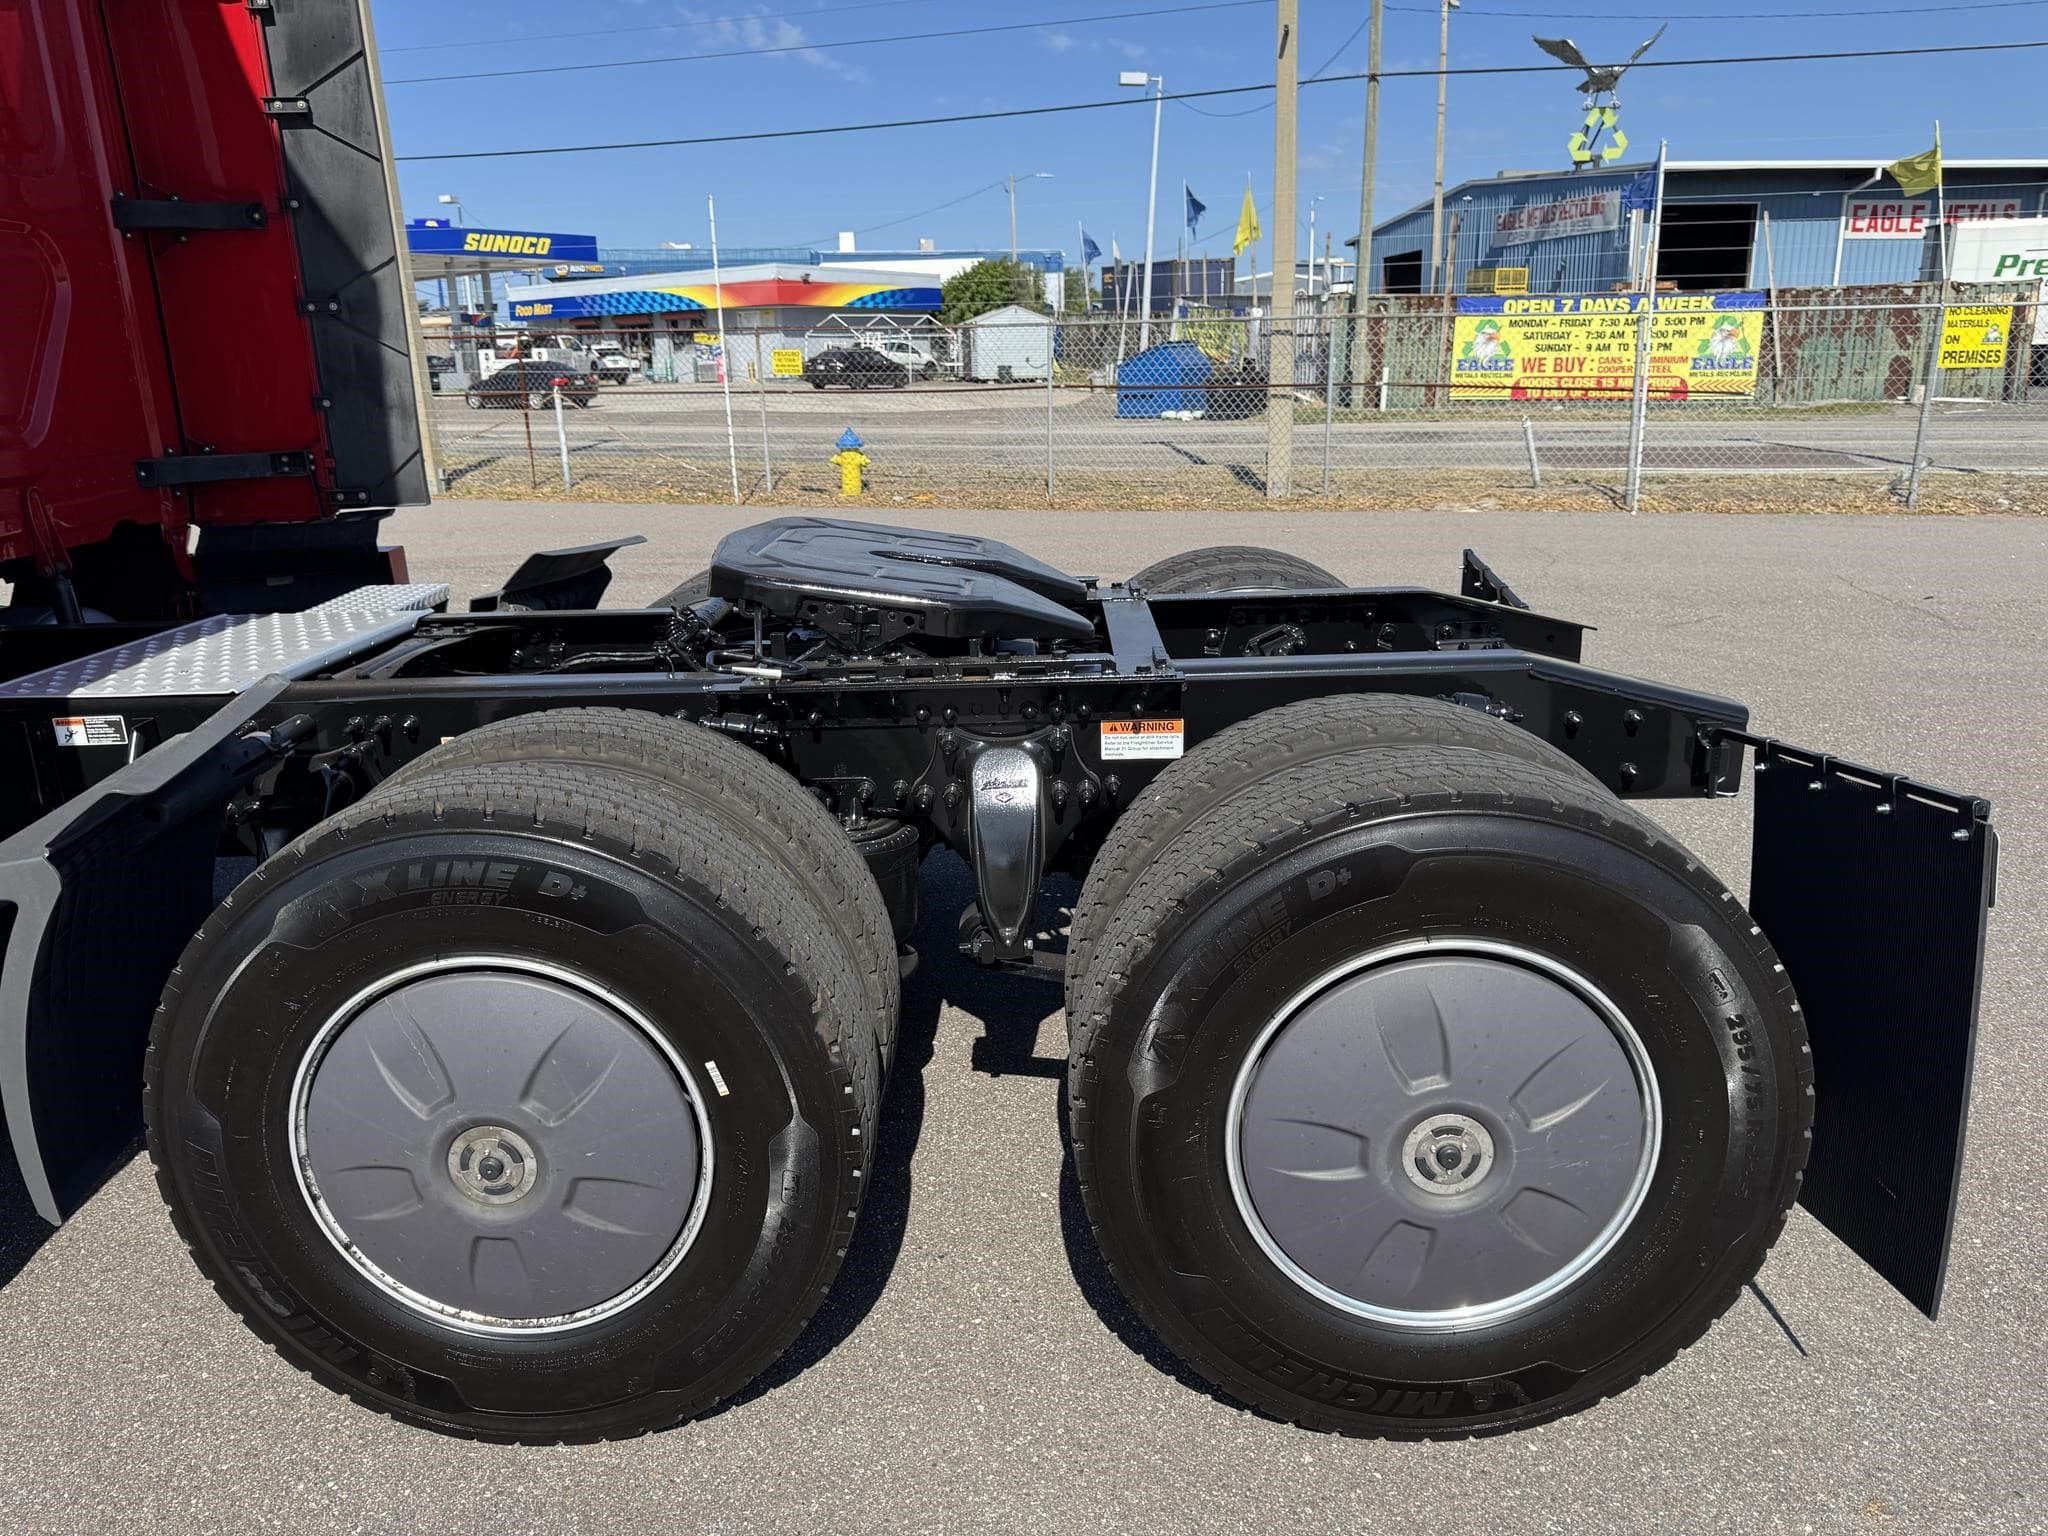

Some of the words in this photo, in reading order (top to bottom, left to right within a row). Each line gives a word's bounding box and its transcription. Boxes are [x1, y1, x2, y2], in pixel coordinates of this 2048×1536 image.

[1850, 204, 1926, 233] EAGLE
[1943, 202, 2016, 222] METALS
[463, 233, 552, 255] SUNOCO
[515, 304, 532, 316] FOOD
[534, 304, 553, 316] MART
[1503, 298, 1555, 313] OPEN
[1562, 298, 1575, 313] 7
[1580, 298, 1631, 312] DAYS
[1635, 297, 1651, 312] A
[1656, 296, 1717, 310] WEEK
[1948, 306, 1962, 316] NO
[1964, 306, 2008, 316] CLEANING
[1508, 319, 1548, 328] MONDAY
[1560, 318, 1593, 328] FRIDAY
[1600, 318, 1620, 326] 7:30
[1664, 317, 1686, 326] 5:00
[1690, 316, 1706, 326] PM
[1948, 319, 1990, 328] MATERIALS
[1522, 331, 1572, 340] SATURDAY
[1586, 330, 1606, 340] 7:30
[1608, 330, 1625, 339] AM
[1650, 330, 1668, 338] :00
[1672, 330, 1688, 338] PM
[1944, 335, 1960, 344] ON
[1535, 344, 1573, 352] SUNDAY
[1586, 344, 1592, 352] 9
[1595, 343, 1611, 352] AM
[1618, 343, 1630, 352] TO
[1656, 342, 1672, 351] PM
[1598, 356, 1623, 364] CANS
[1690, 356, 1754, 370] EAGLE
[1942, 350, 2002, 364] PREMISES
[1456, 358, 1515, 372] EAGLE
[1521, 356, 1546, 373] WE
[1552, 356, 1588, 373] BUY
[1597, 366, 1634, 374] COOPER
[1520, 378, 1560, 387] DOORS
[1560, 378, 1598, 387] CLOSE
[1600, 378, 1615, 386] 15
[1120, 722, 1174, 732] WARNING
[407, 860, 520, 890] LINE
[429, 890, 509, 906] ENERGY
